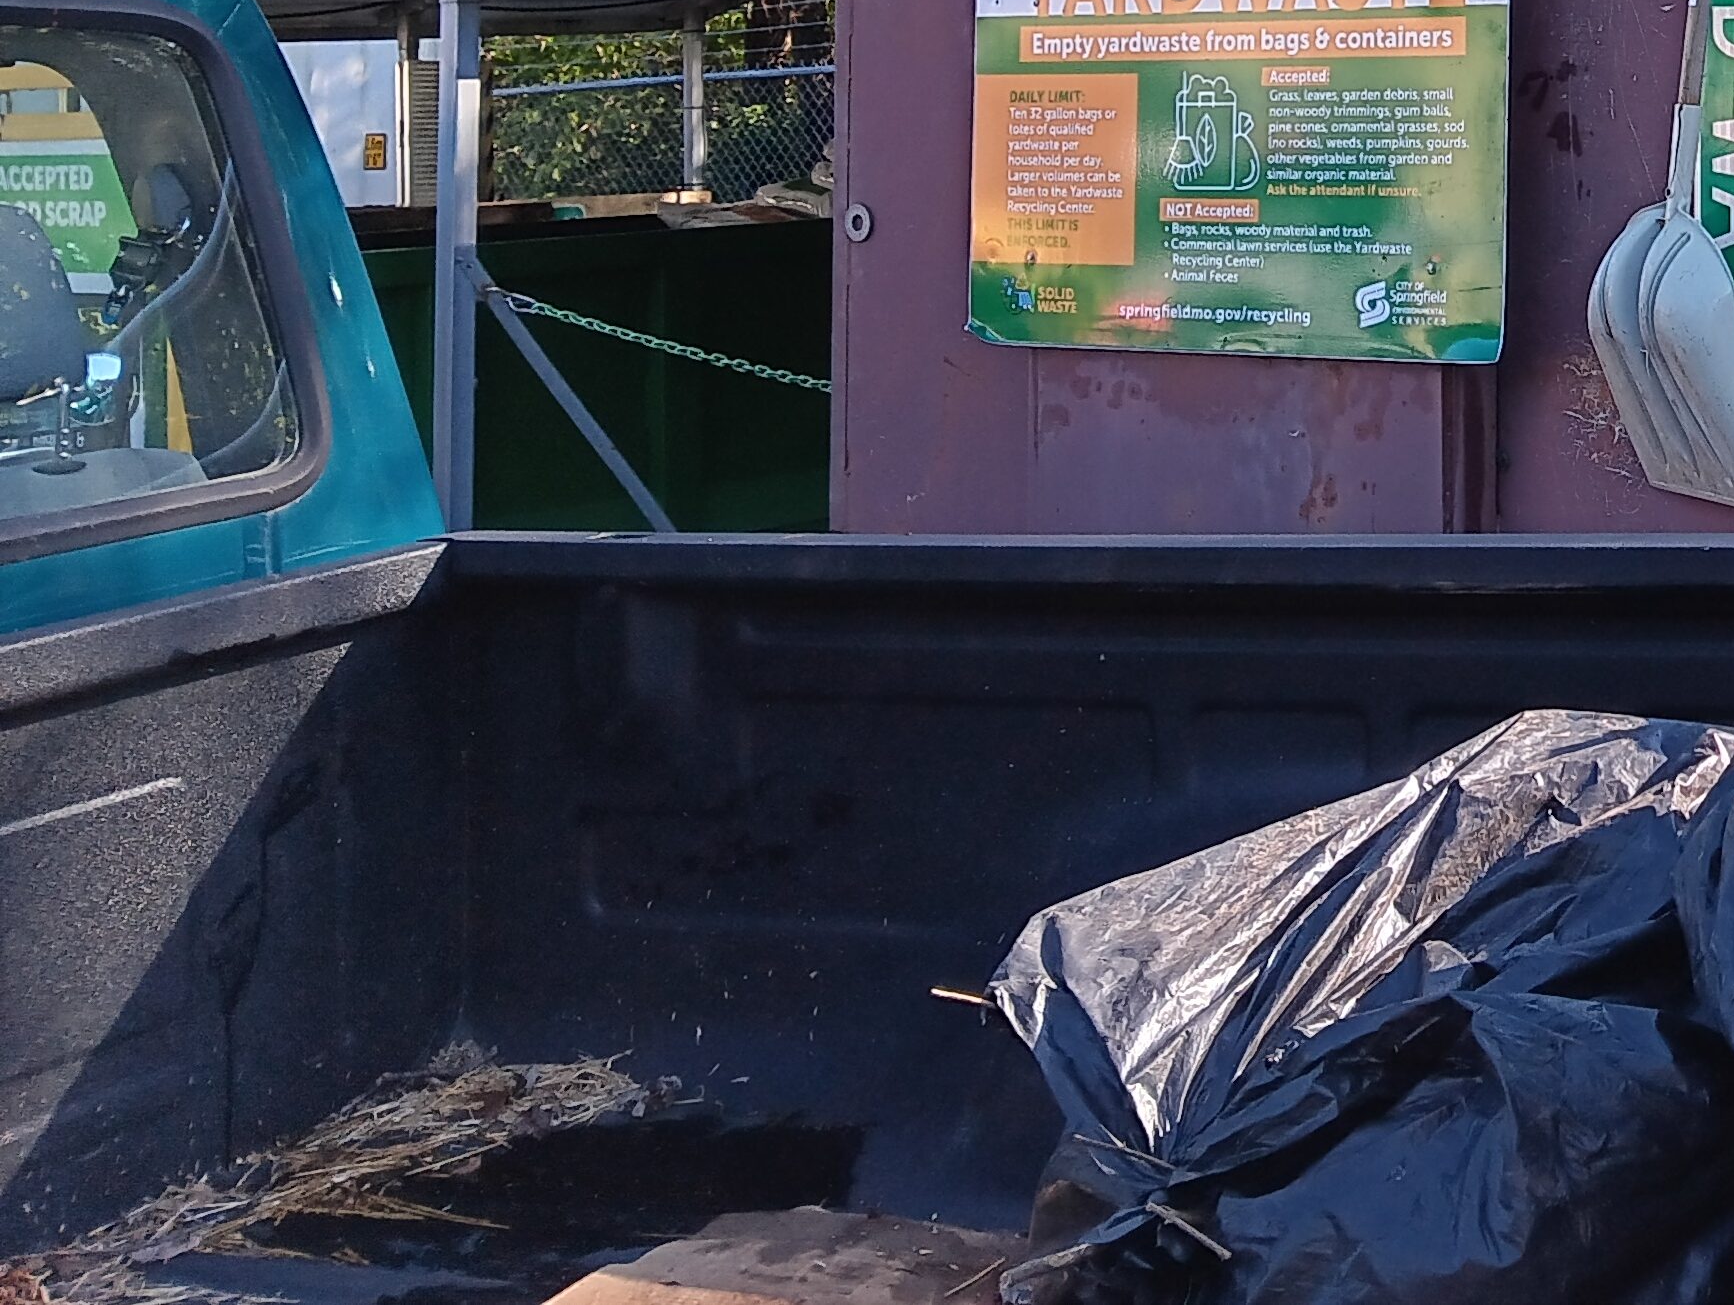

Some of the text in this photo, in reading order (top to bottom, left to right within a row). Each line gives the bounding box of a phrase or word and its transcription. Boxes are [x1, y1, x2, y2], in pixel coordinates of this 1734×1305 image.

[1033, 25, 1451, 58] Empty yardwaste from bags & containers
[1269, 70, 1329, 85] Accepted:
[1010, 90, 1085, 103] DAILY LIMIT:
[1269, 87, 1453, 104] Grass, leaves, garden debris, small
[1009, 107, 1116, 121] Ten 32 gallon bags or
[1269, 106, 1331, 119] non-woody
[1334, 105, 1392, 119] trimmings,
[1394, 107, 1420, 119] gum
[1009, 124, 1093, 137] totes of qualified
[1269, 121, 1291, 134] pine
[1331, 120, 1394, 132] ornamental
[1397, 123, 1440, 135] grasses,
[1444, 120, 1464, 131] sod
[1008, 140, 1079, 153] yardwaste per
[1326, 137, 1364, 149] weeds,
[1366, 136, 1424, 151] pumpkins,
[1008, 155, 1060, 166] household
[1064, 157, 1080, 168] per
[1267, 152, 1452, 167] other vegetables from garden and
[0, 165, 93, 191] ACCEPTED
[1008, 170, 1120, 183] Larger volumes can be
[1266, 167, 1396, 183] similar organic material.
[1008, 186, 1122, 199] taken to the Yardwaste
[1266, 184, 1287, 196] Ask
[1289, 183, 1307, 196] the
[1310, 184, 1365, 196] attendant
[1367, 184, 1375, 196] if
[45, 201, 106, 227] SCRAP
[1007, 201, 1096, 216] Recycling Center.
[1167, 202, 1253, 219] NOT Accepted:
[1008, 218, 1079, 231] THIS LIMIT IS
[1172, 223, 1198, 236] Bags,
[1201, 223, 1232, 236] rocks,
[1235, 224, 1271, 238] woody
[1274, 224, 1317, 237] material
[1320, 225, 1339, 237] and
[1171, 239, 1234, 251] Commercial
[1237, 239, 1262, 252] lawn
[1265, 240, 1307, 253] services
[1334, 241, 1352, 254] the
[1355, 241, 1412, 255] Yardwaste
[1173, 255, 1222, 269] Recycling
[1171, 270, 1238, 283] Animal Feces
[1396, 281, 1424, 290] CITY OF
[1038, 286, 1074, 300] SOLID
[1390, 290, 1447, 306] Springfield
[1037, 300, 1077, 313] WASTE
[1118, 303, 1311, 325] springfieldmo.gov/recycling
[1392, 316, 1446, 326] SERVICES
